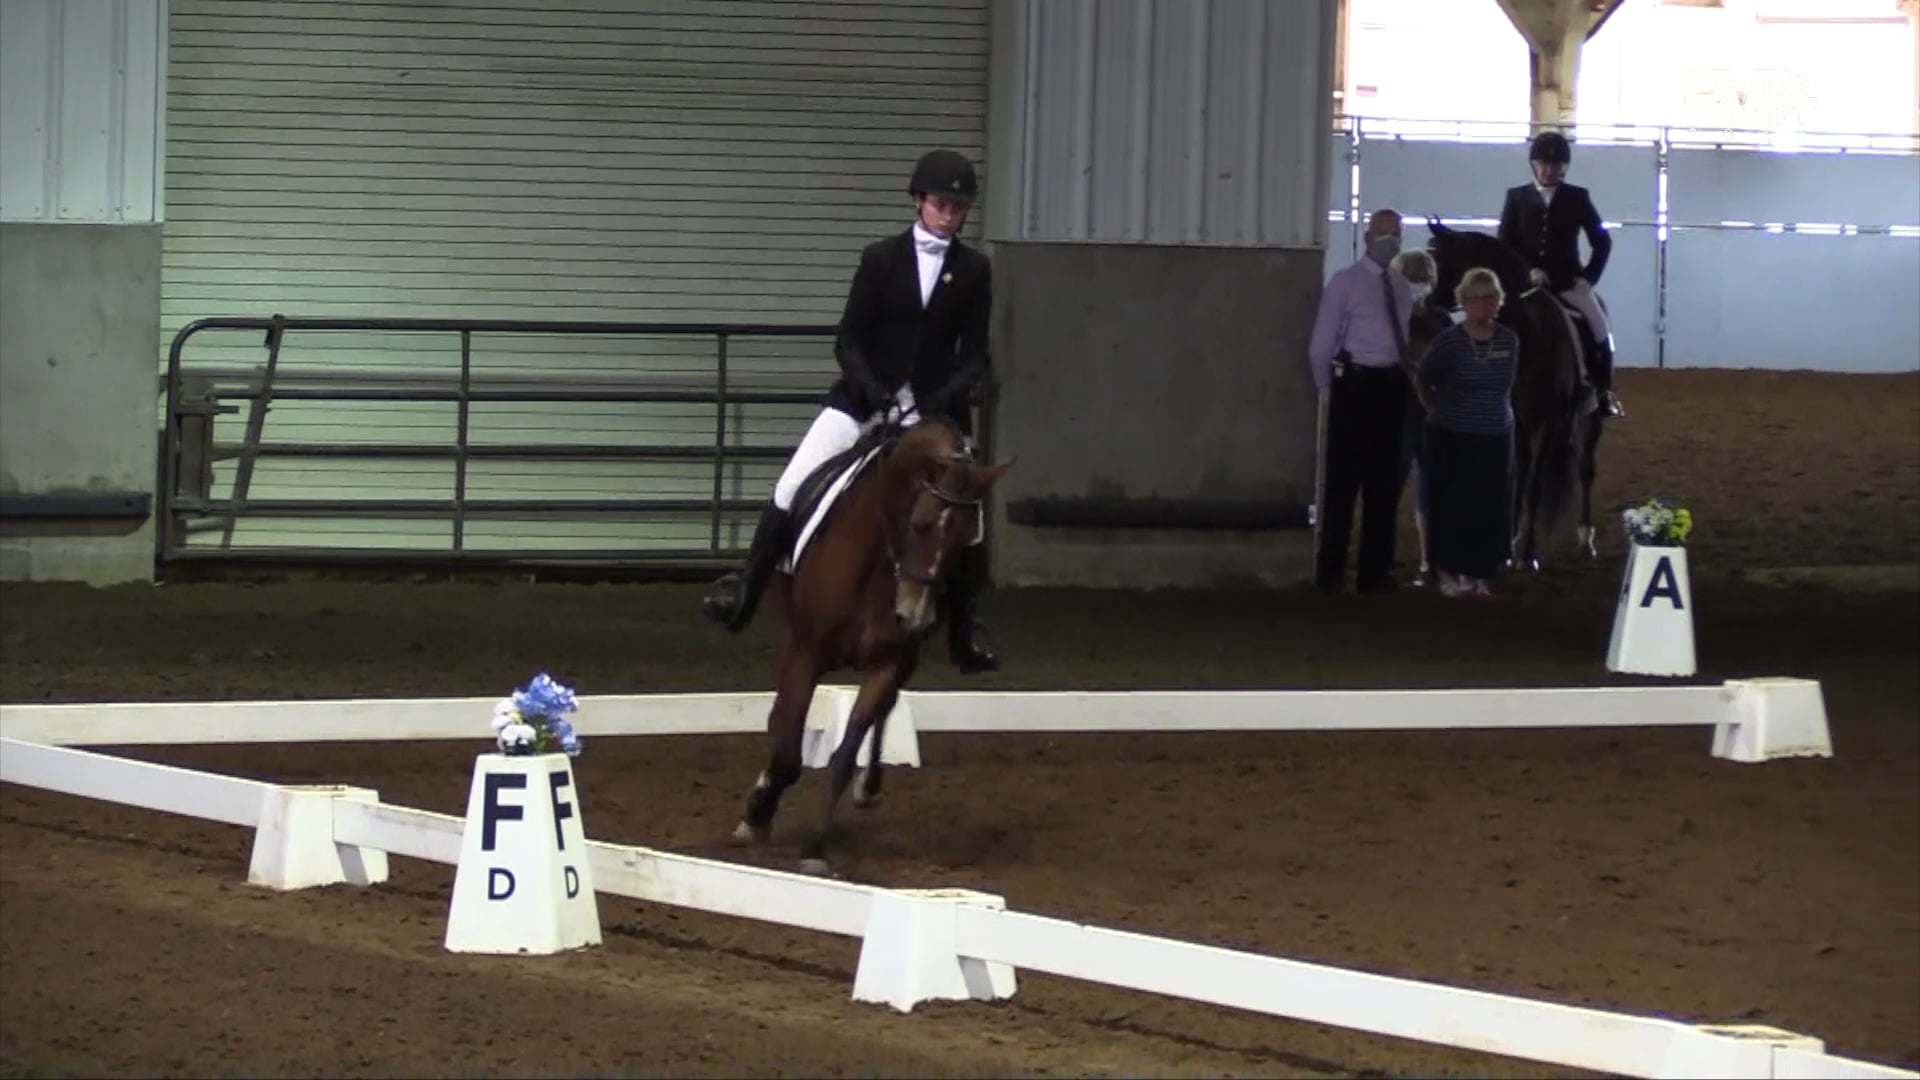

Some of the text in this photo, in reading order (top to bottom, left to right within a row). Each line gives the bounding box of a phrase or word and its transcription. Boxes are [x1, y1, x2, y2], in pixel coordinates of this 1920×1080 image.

[1639, 555, 1685, 610] A
[481, 773, 528, 852] F
[548, 770, 573, 852] F
[487, 867, 517, 901] D
[564, 865, 580, 899] D
